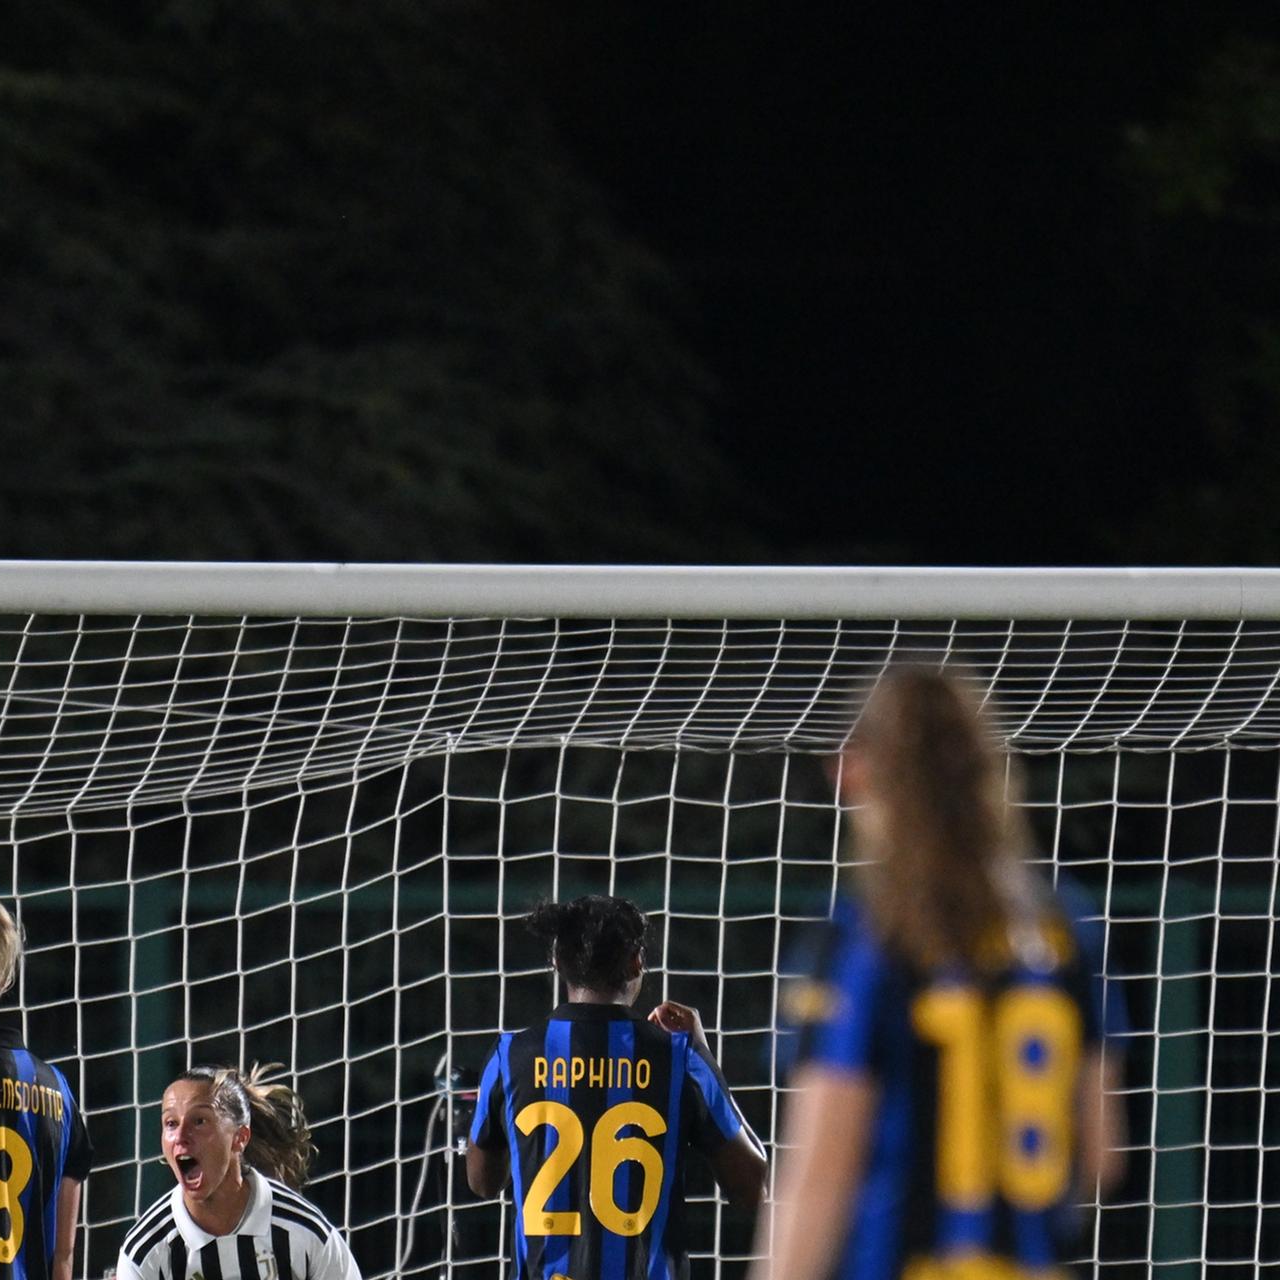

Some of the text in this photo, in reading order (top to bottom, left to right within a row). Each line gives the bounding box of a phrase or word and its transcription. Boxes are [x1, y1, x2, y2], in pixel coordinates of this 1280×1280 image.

[533, 1056, 652, 1090] RAPHINO
[910, 985, 1085, 1212] 18
[514, 1100, 668, 1237] 26
